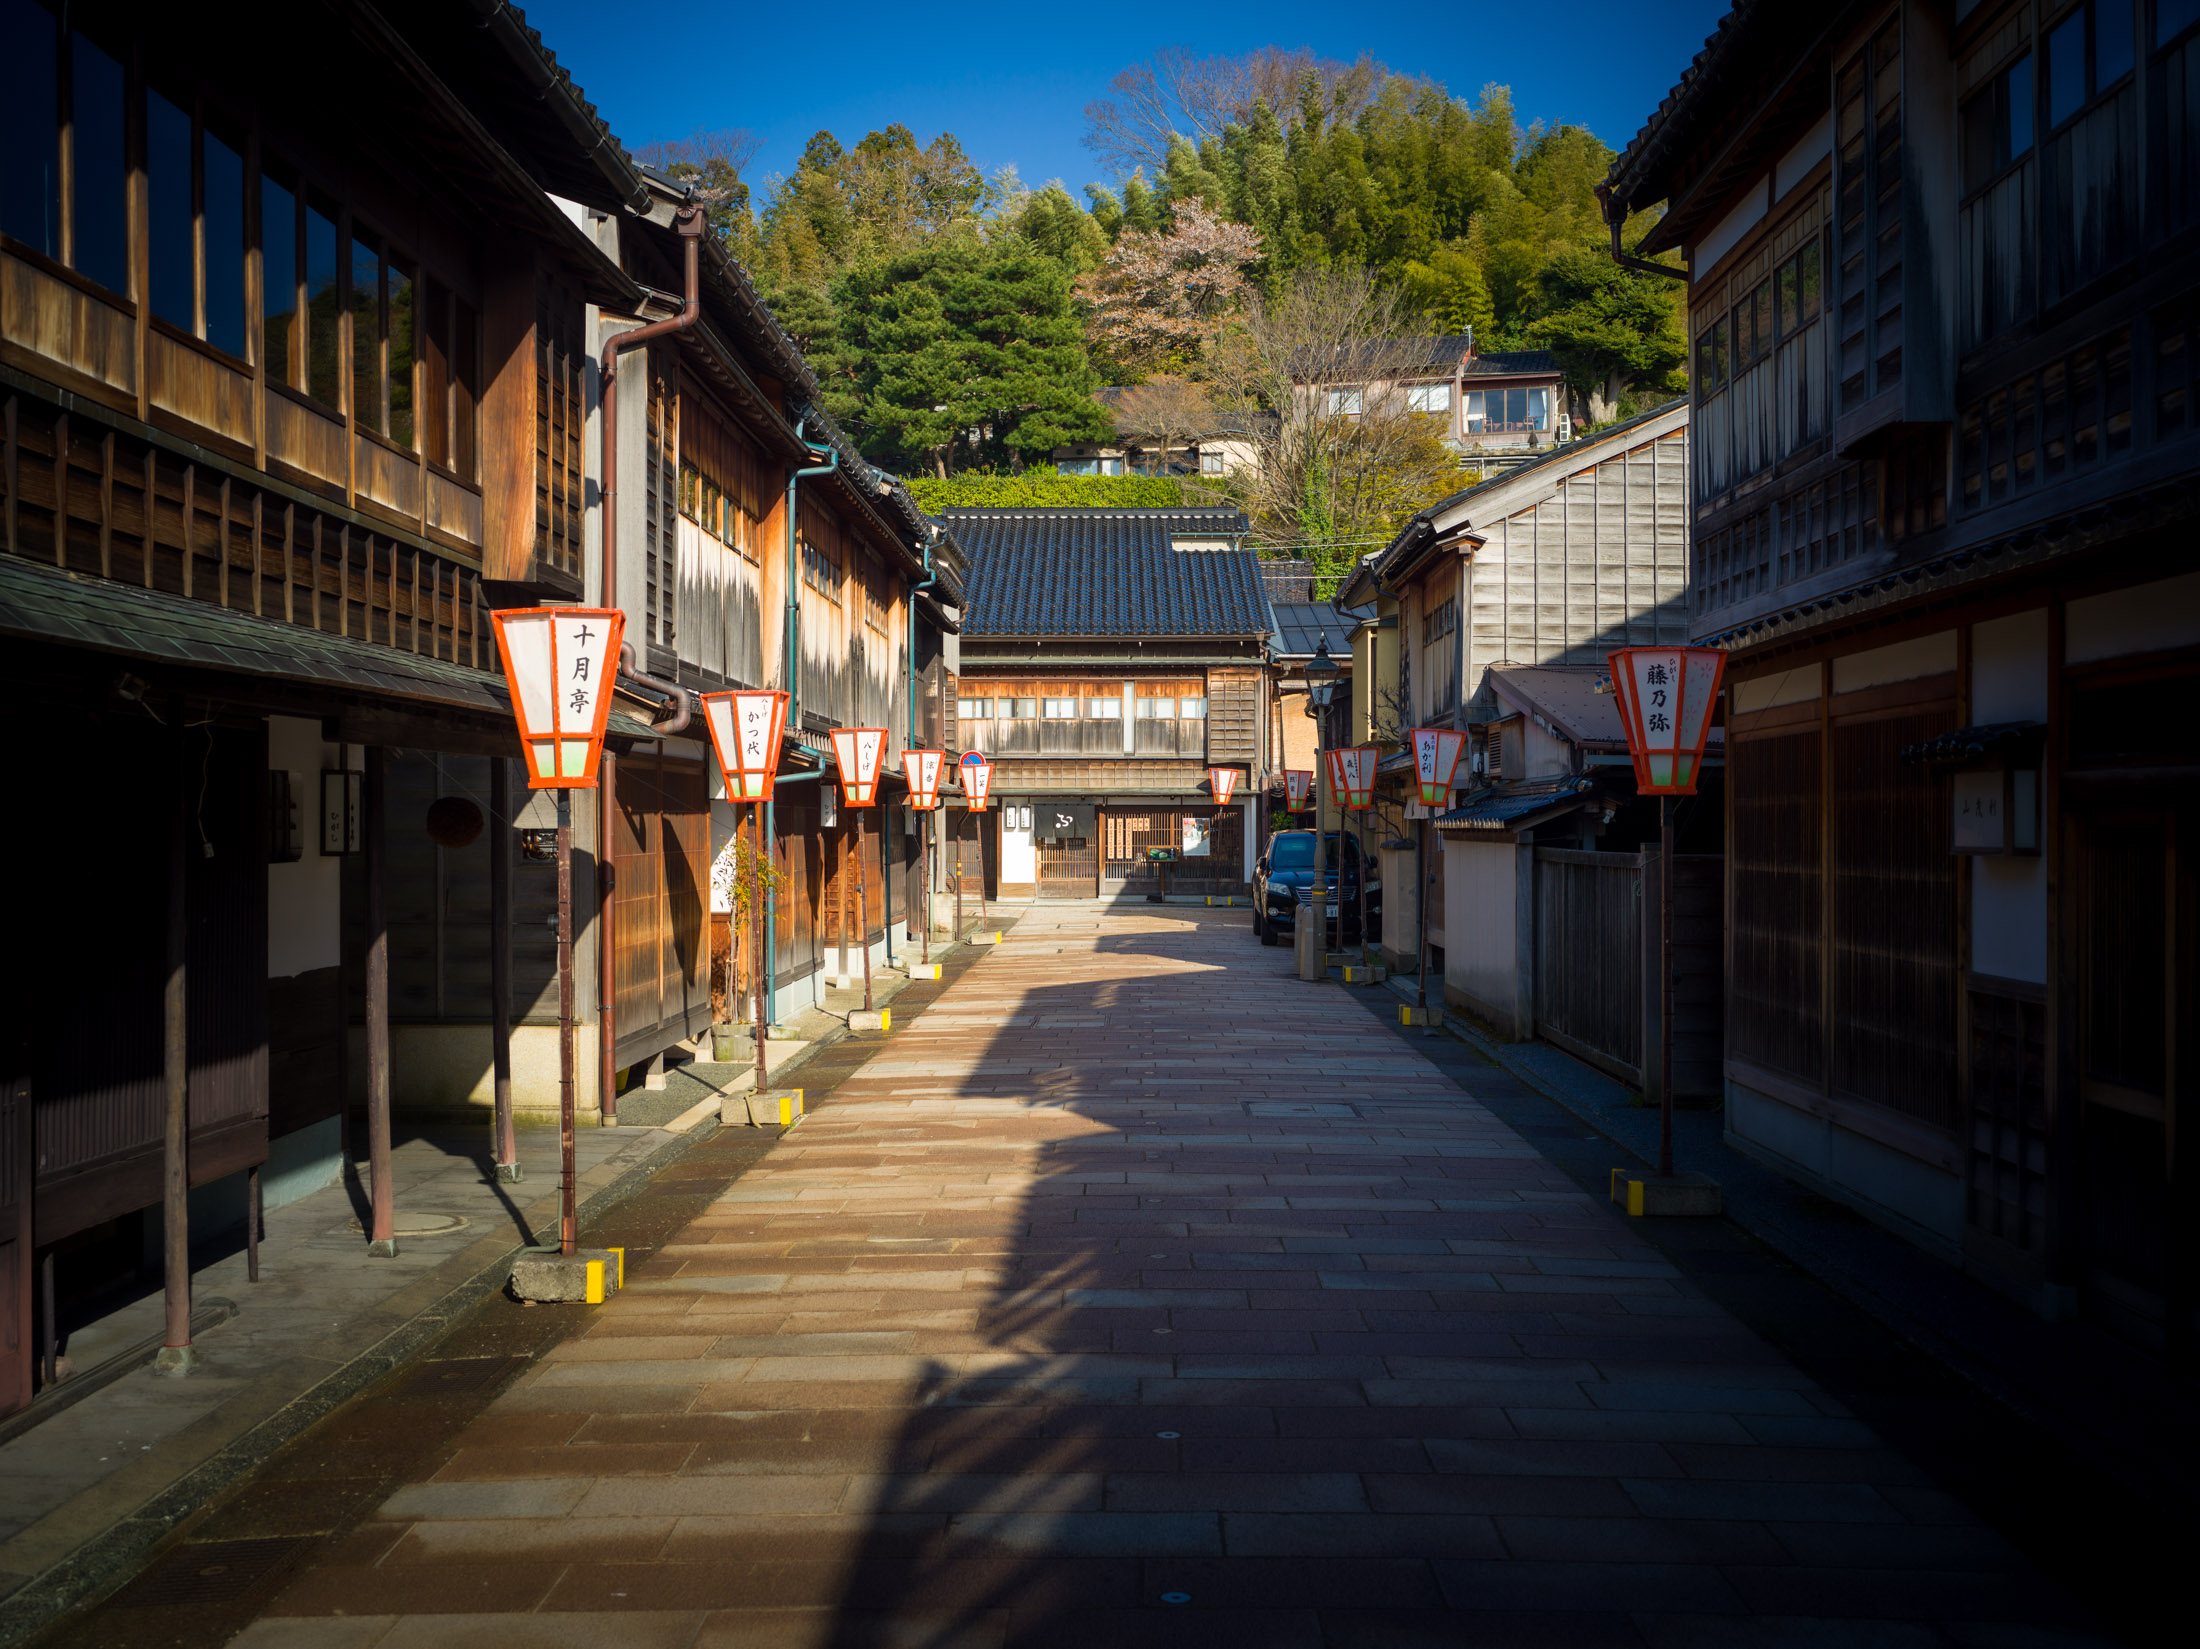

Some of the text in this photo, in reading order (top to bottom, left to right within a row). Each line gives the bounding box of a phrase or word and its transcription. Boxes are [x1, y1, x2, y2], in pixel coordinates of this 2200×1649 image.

[570, 624, 595, 714] 十月亭
[1647, 664, 1670, 732] 藤乃弥
[747, 712, 760, 755] かつ代
